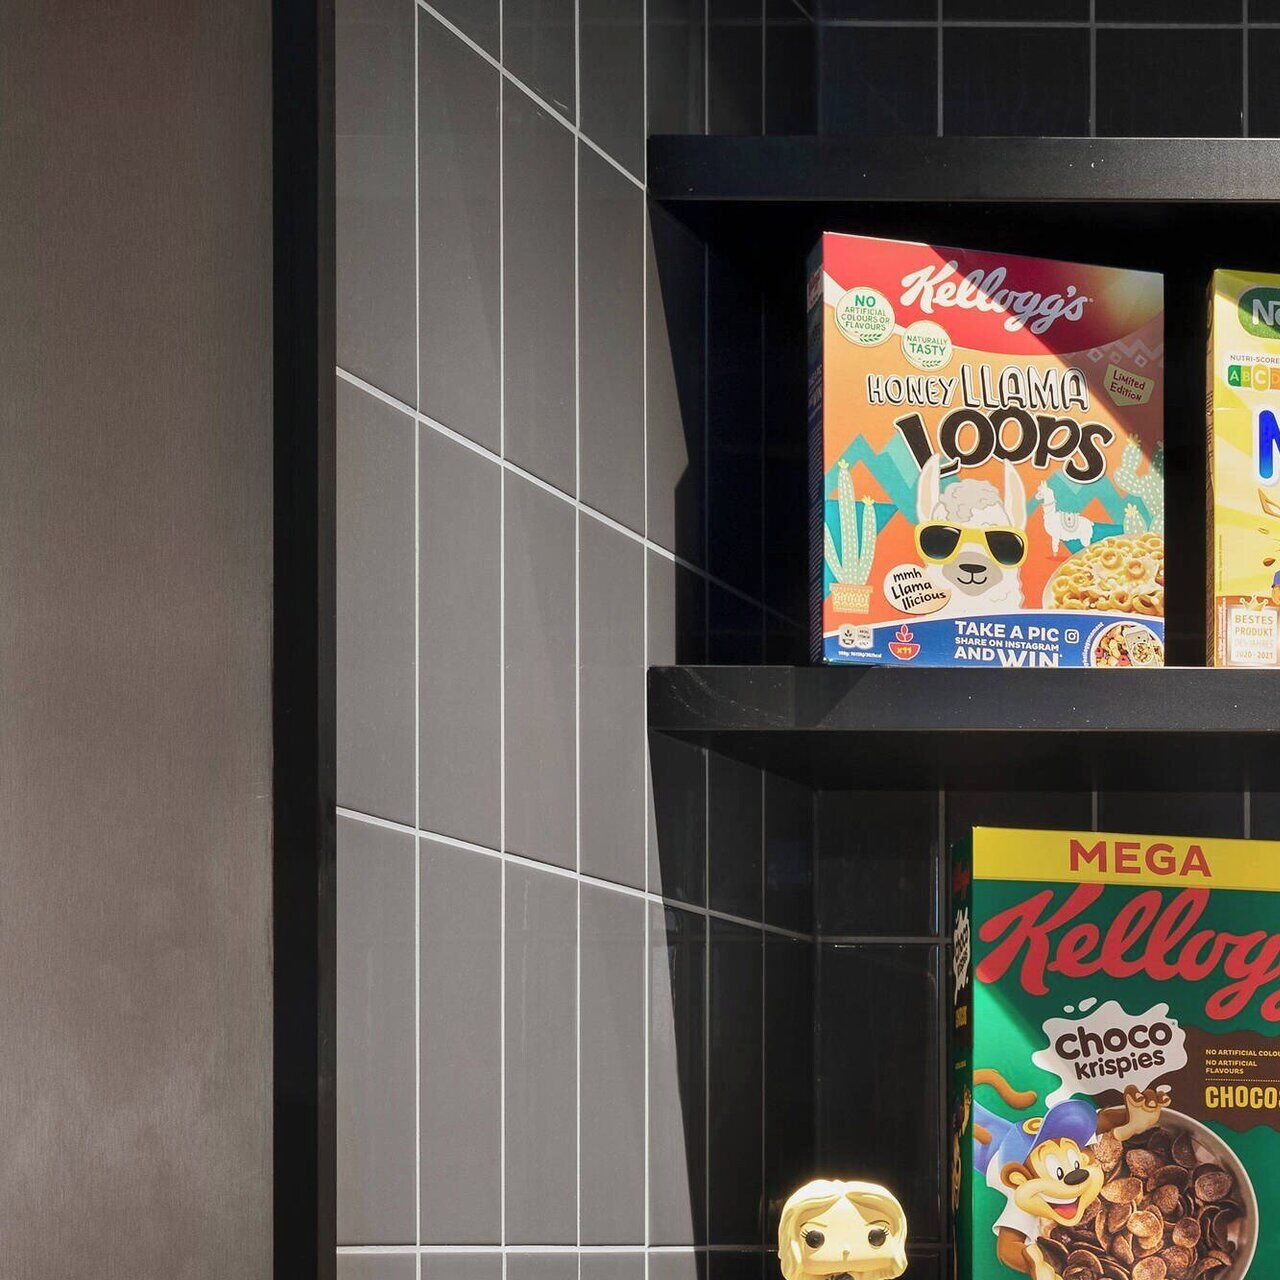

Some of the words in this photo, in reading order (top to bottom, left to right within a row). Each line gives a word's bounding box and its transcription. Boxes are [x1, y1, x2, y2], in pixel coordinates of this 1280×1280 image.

[855, 295, 876, 307] NO
[900, 260, 1089, 334] Kellogg's
[845, 306, 886, 317] ARTIFICIAL
[841, 313, 878, 324] COLOURS
[845, 321, 886, 331] FLAVOURS
[906, 335, 948, 345] NATURALLY
[910, 343, 946, 356] TASTY
[1230, 354, 1280, 364] NUTRI-SCORE
[867, 374, 959, 407] HONEY
[961, 364, 1089, 413] LLAMA
[893, 568, 922, 583] mmh
[891, 581, 932, 600] Llama
[1234, 614, 1273, 625] BESTES
[954, 620, 1007, 639] TAKE
[1010, 625, 1024, 640] A
[1027, 627, 1060, 643] PIC
[1234, 626, 1273, 637] PRODUKT
[954, 637, 987, 646] SHARE
[988, 640, 1003, 648] ON
[1004, 641, 1060, 652] INSTAGRAM
[954, 646, 996, 661] AND
[1068, 838, 1213, 878] MEGA
[1055, 1022, 1173, 1060] choco
[1218, 1049, 1258, 1057] ARTIFICIAL
[1074, 1050, 1166, 1080] krispies
[1205, 1067, 1245, 1075] FLAVOURS
